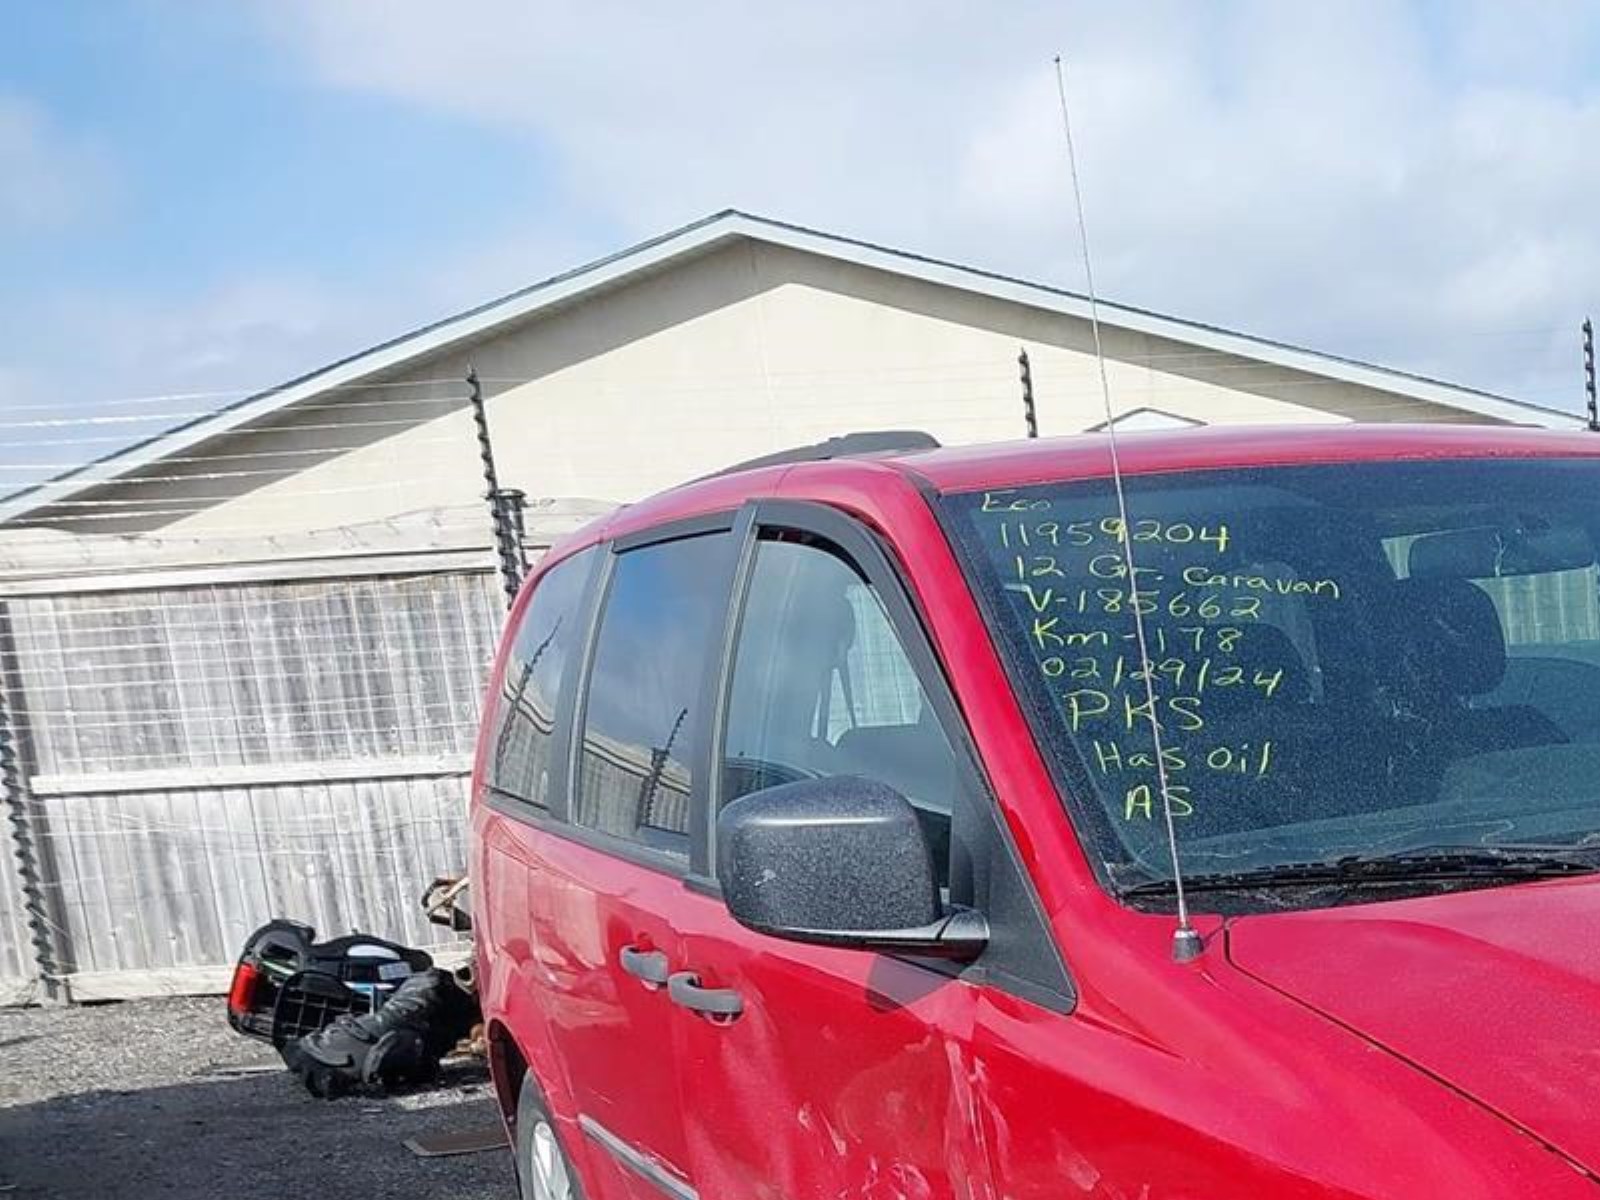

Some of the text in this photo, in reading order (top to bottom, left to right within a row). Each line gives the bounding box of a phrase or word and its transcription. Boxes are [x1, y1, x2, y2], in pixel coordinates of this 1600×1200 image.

[1000, 516, 1230, 552] 11959204
[1016, 555, 1065, 580] 12
[1182, 566, 1340, 599] Caravan
[1040, 656, 1284, 697] 02/29/24
[1094, 740, 1188, 775] Has
